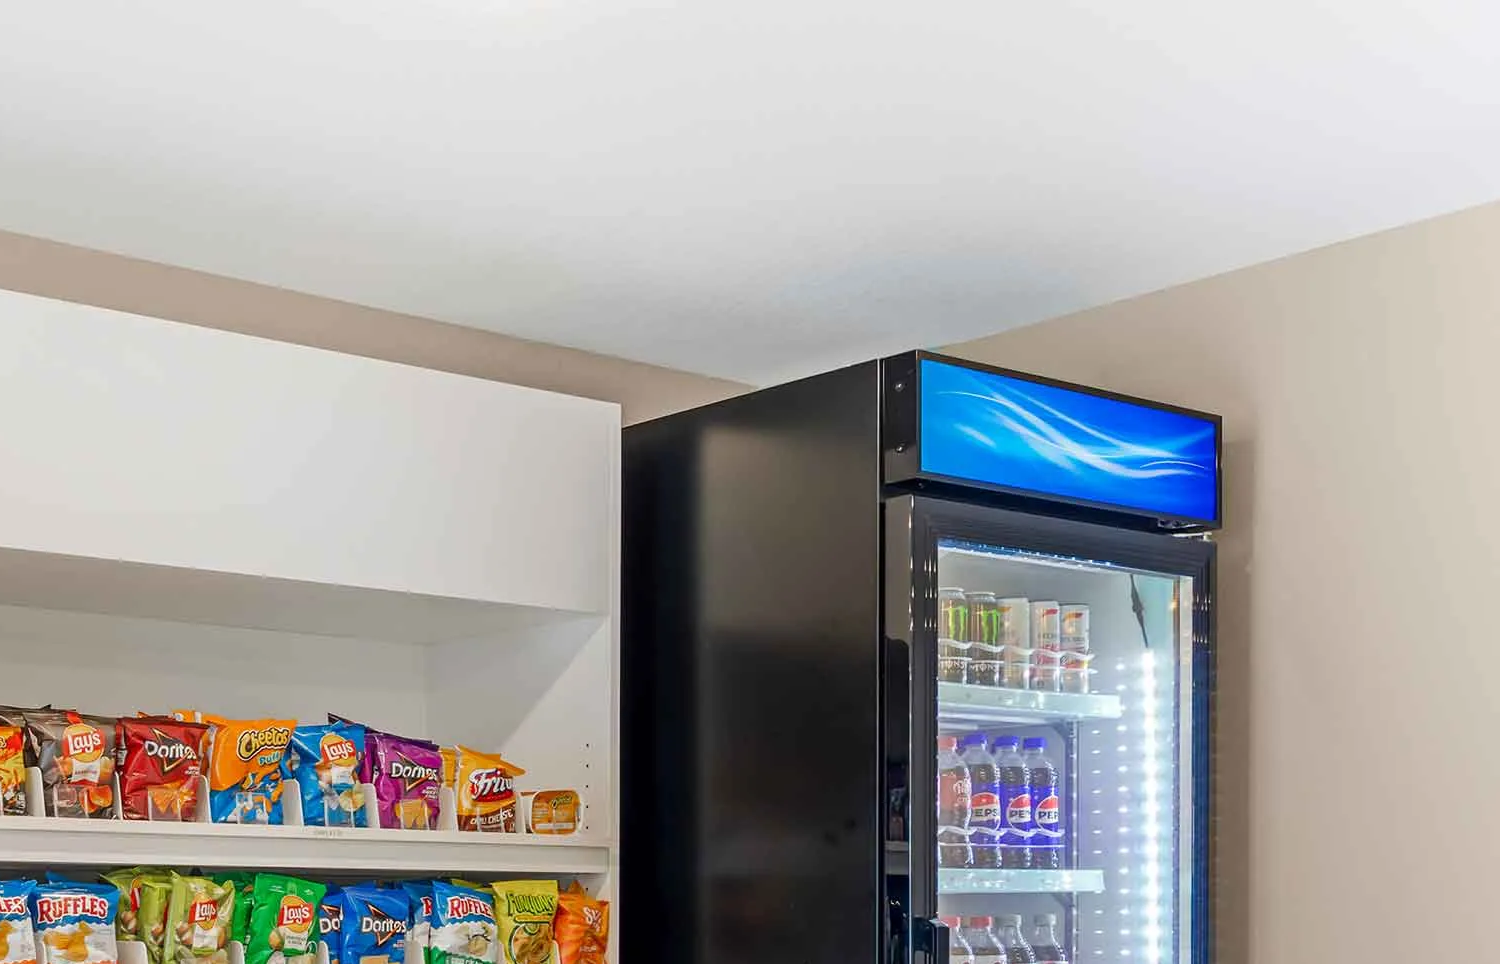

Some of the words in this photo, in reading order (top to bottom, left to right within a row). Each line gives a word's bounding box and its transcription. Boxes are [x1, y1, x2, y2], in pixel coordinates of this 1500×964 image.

[67, 732, 102, 755] Lay's
[238, 727, 290, 759] Cheetos
[258, 752, 280, 765] Puff
[974, 806, 998, 817] EPS
[1038, 810, 1058, 820] PEP
[38, 896, 108, 923] RUFFLES
[283, 905, 311, 923] Lay's
[362, 917, 406, 933] Doritos
